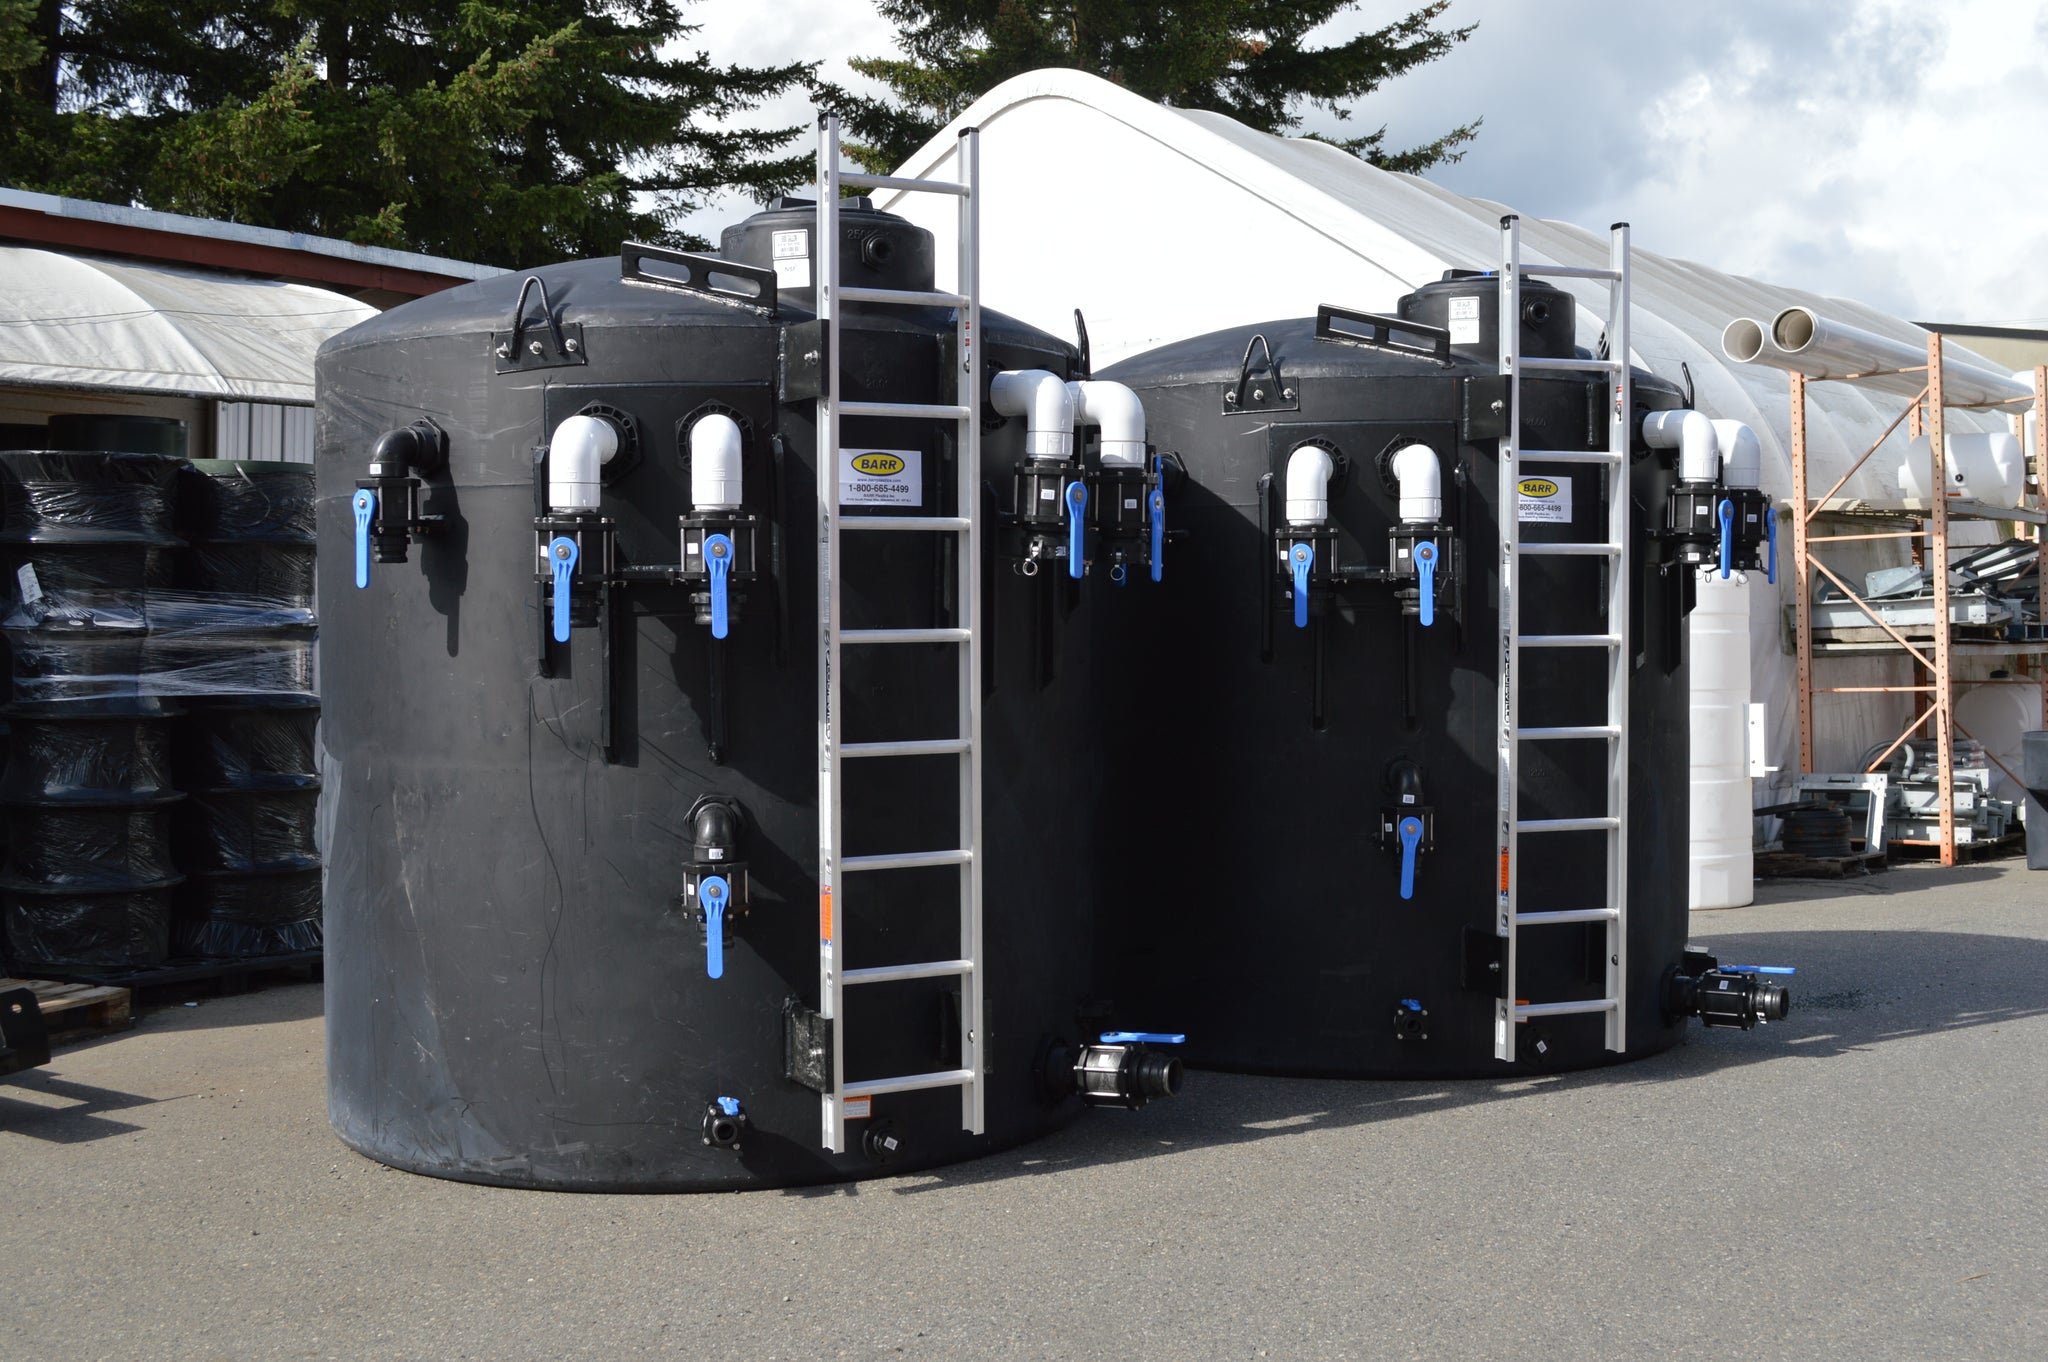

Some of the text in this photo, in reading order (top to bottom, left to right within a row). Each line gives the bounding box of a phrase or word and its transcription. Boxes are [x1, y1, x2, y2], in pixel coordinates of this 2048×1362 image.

[861, 459, 897, 470] BARR
[849, 484, 909, 493] 1-800-665-4499
[1523, 484, 1552, 493] BARR
[1519, 504, 1562, 512] -800-665-4499
